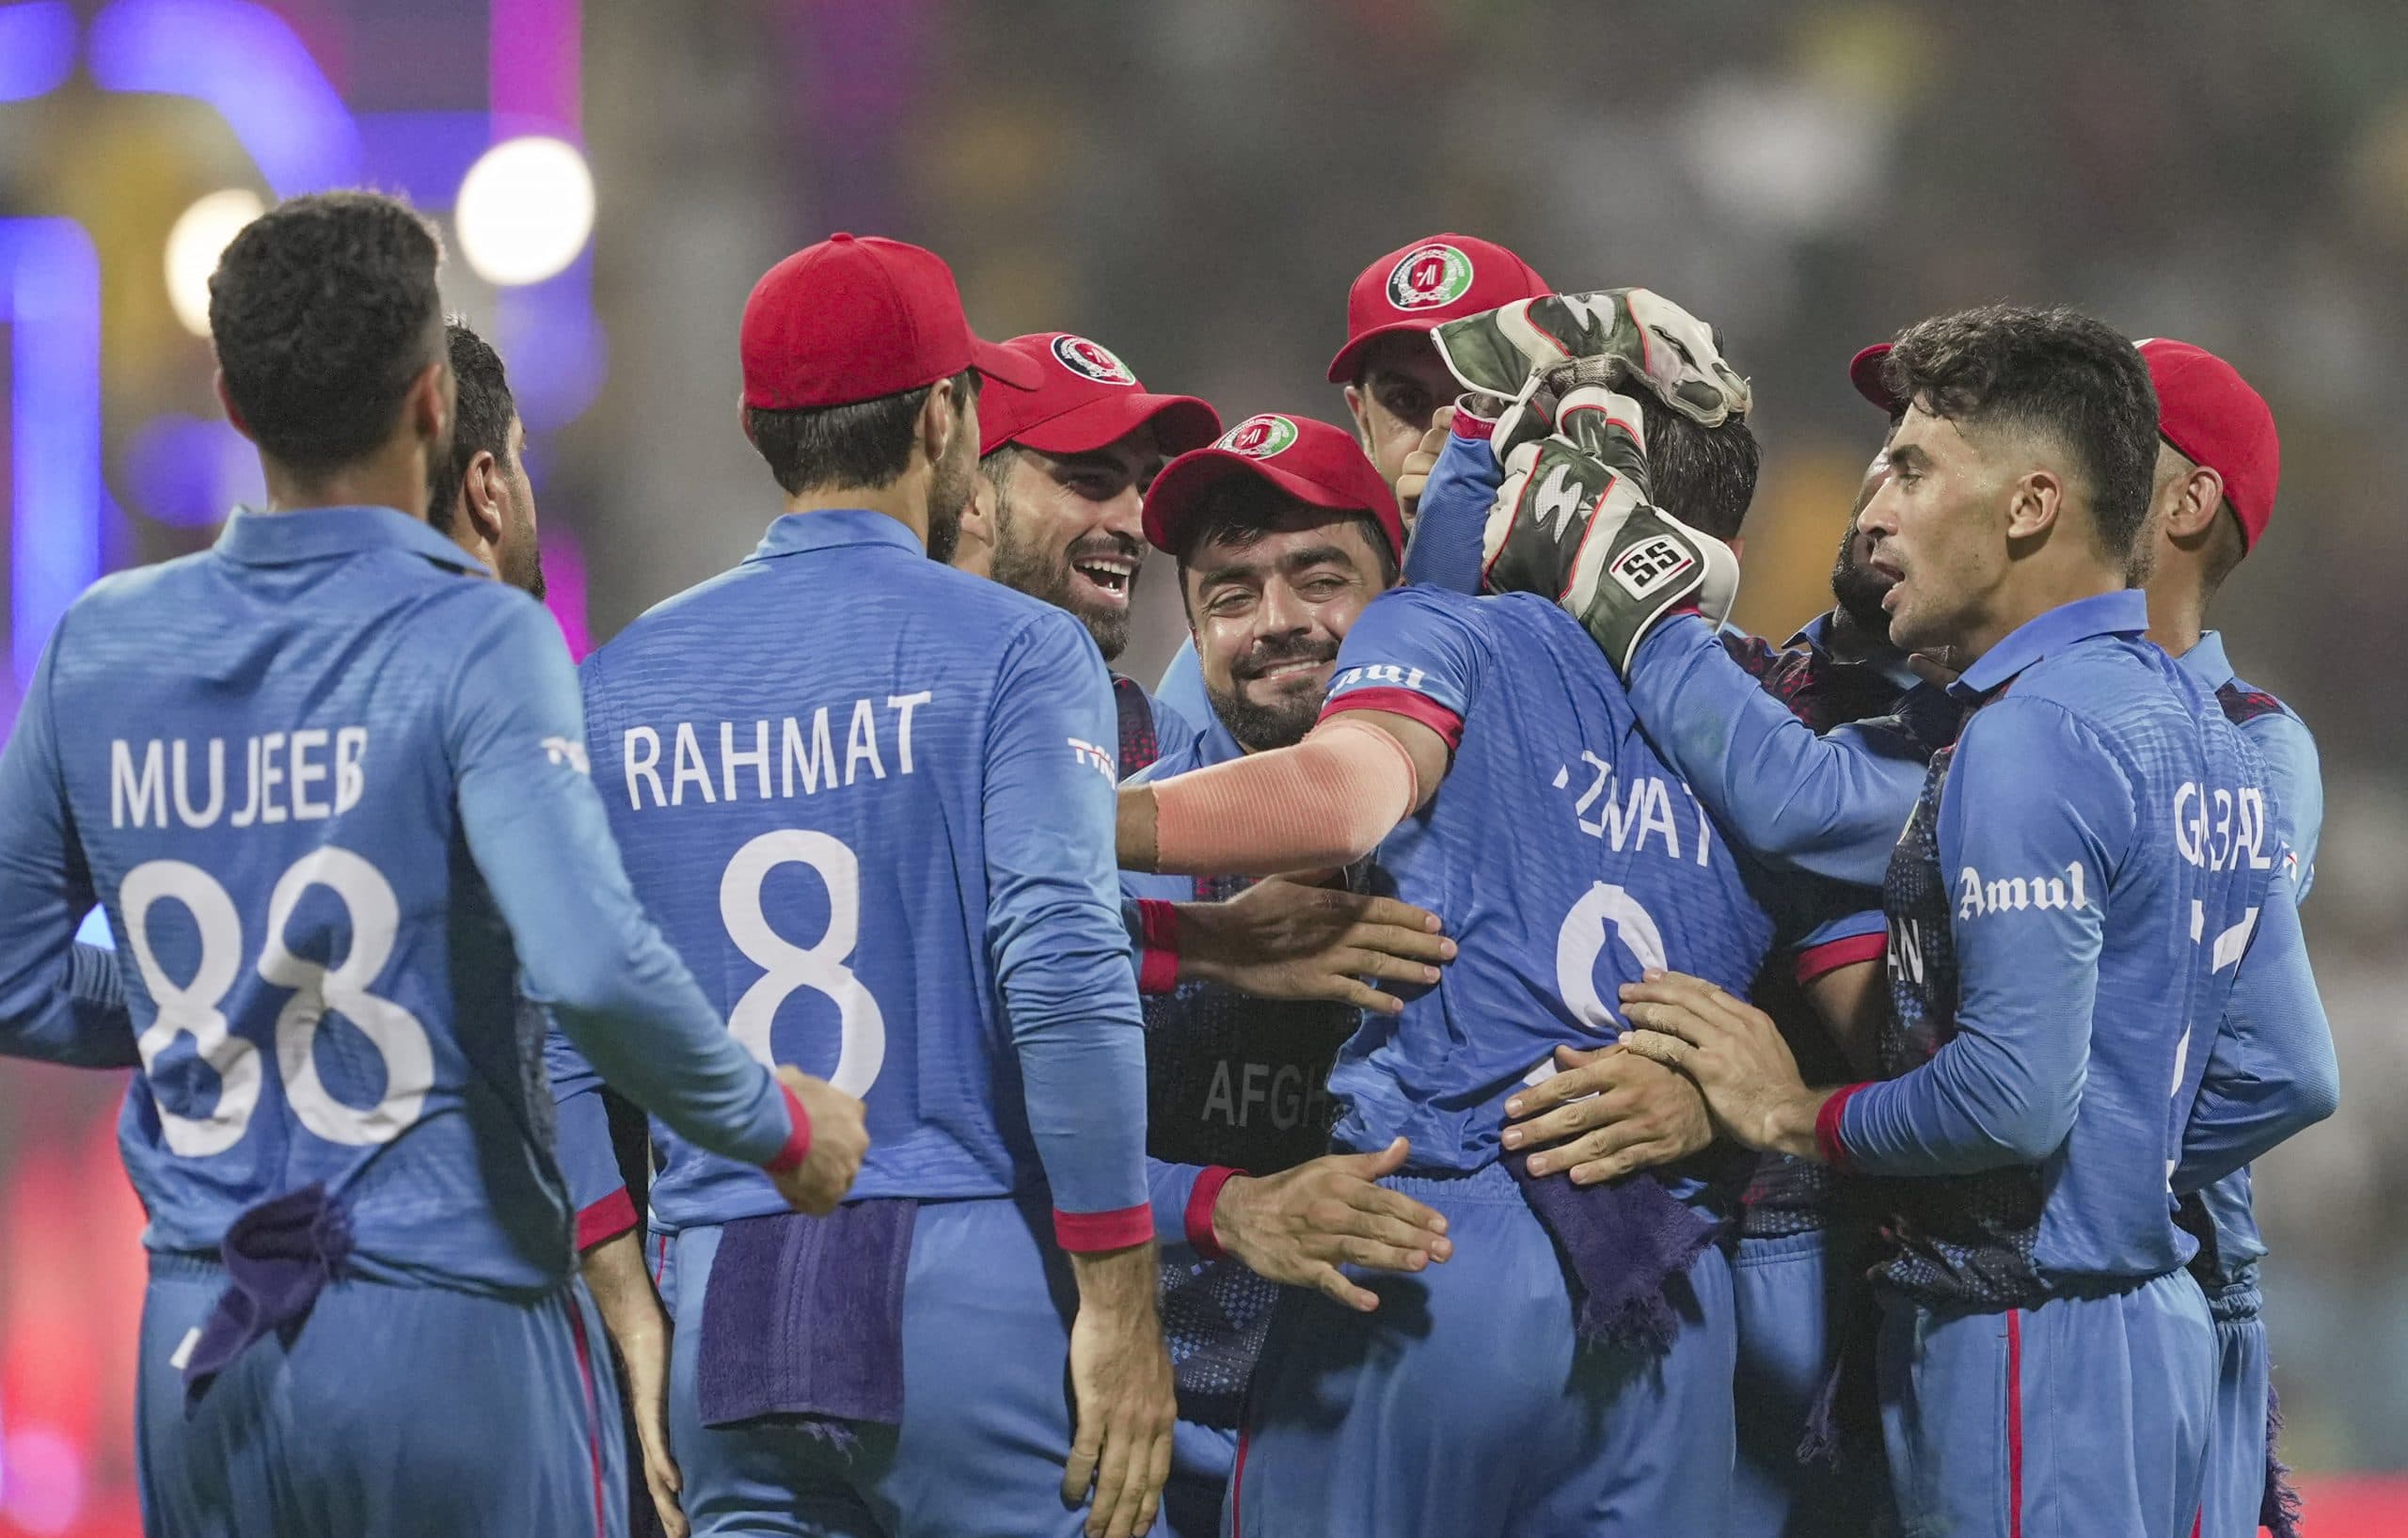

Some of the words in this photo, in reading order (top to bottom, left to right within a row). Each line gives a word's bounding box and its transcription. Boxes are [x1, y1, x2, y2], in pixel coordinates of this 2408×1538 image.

[1623, 540, 1682, 588] SS
[1322, 664, 1426, 709] mul
[111, 727, 368, 830] MUJEEB
[625, 690, 931, 811] RAHMAT
[1958, 862, 2091, 922] Amul
[119, 846, 435, 1158] 88
[720, 829, 886, 1100] 8
